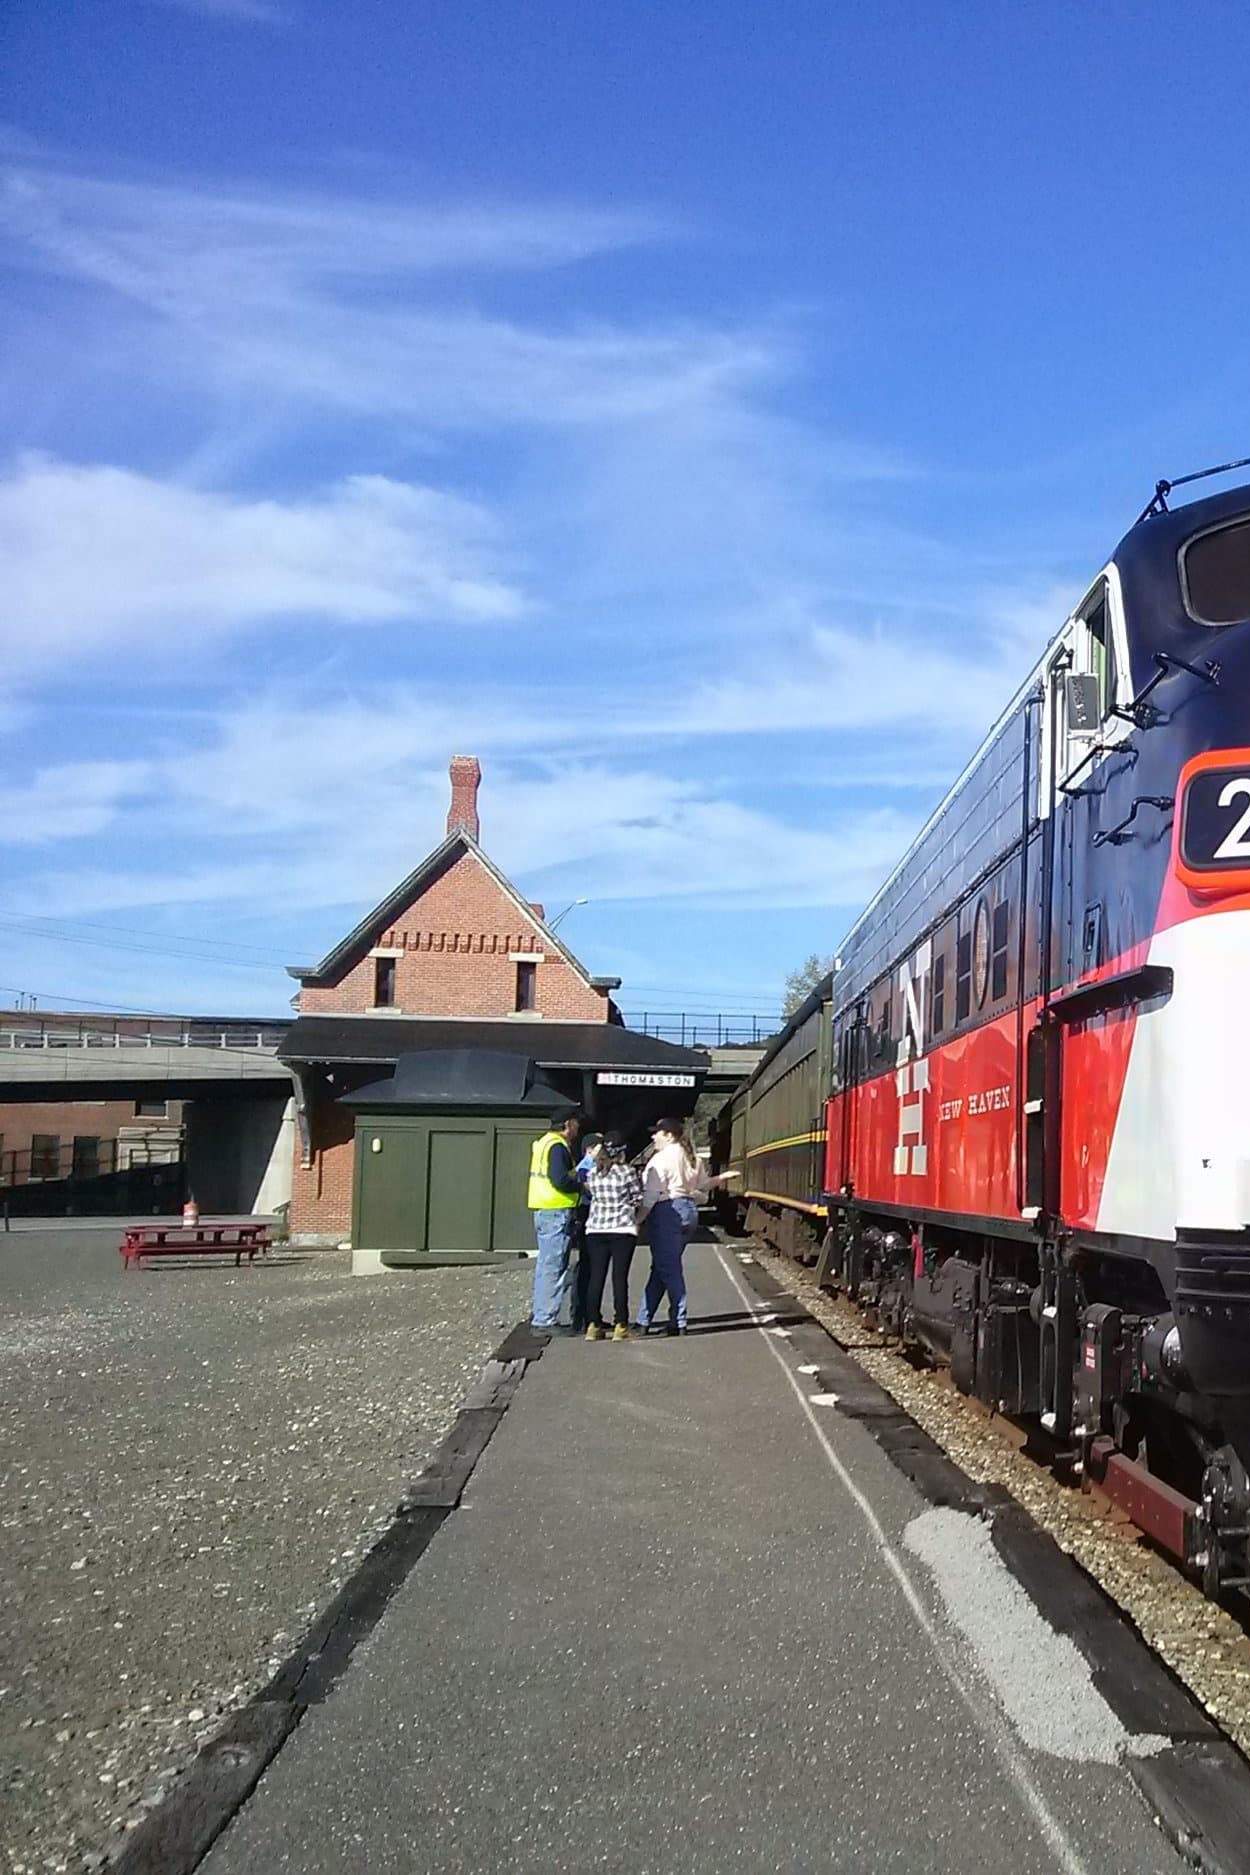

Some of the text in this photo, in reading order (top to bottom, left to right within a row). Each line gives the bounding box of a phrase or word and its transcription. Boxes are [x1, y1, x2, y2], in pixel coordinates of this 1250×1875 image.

[613, 1074, 692, 1086] THOMASTON
[938, 1085, 1010, 1121] NEW HAVEN
